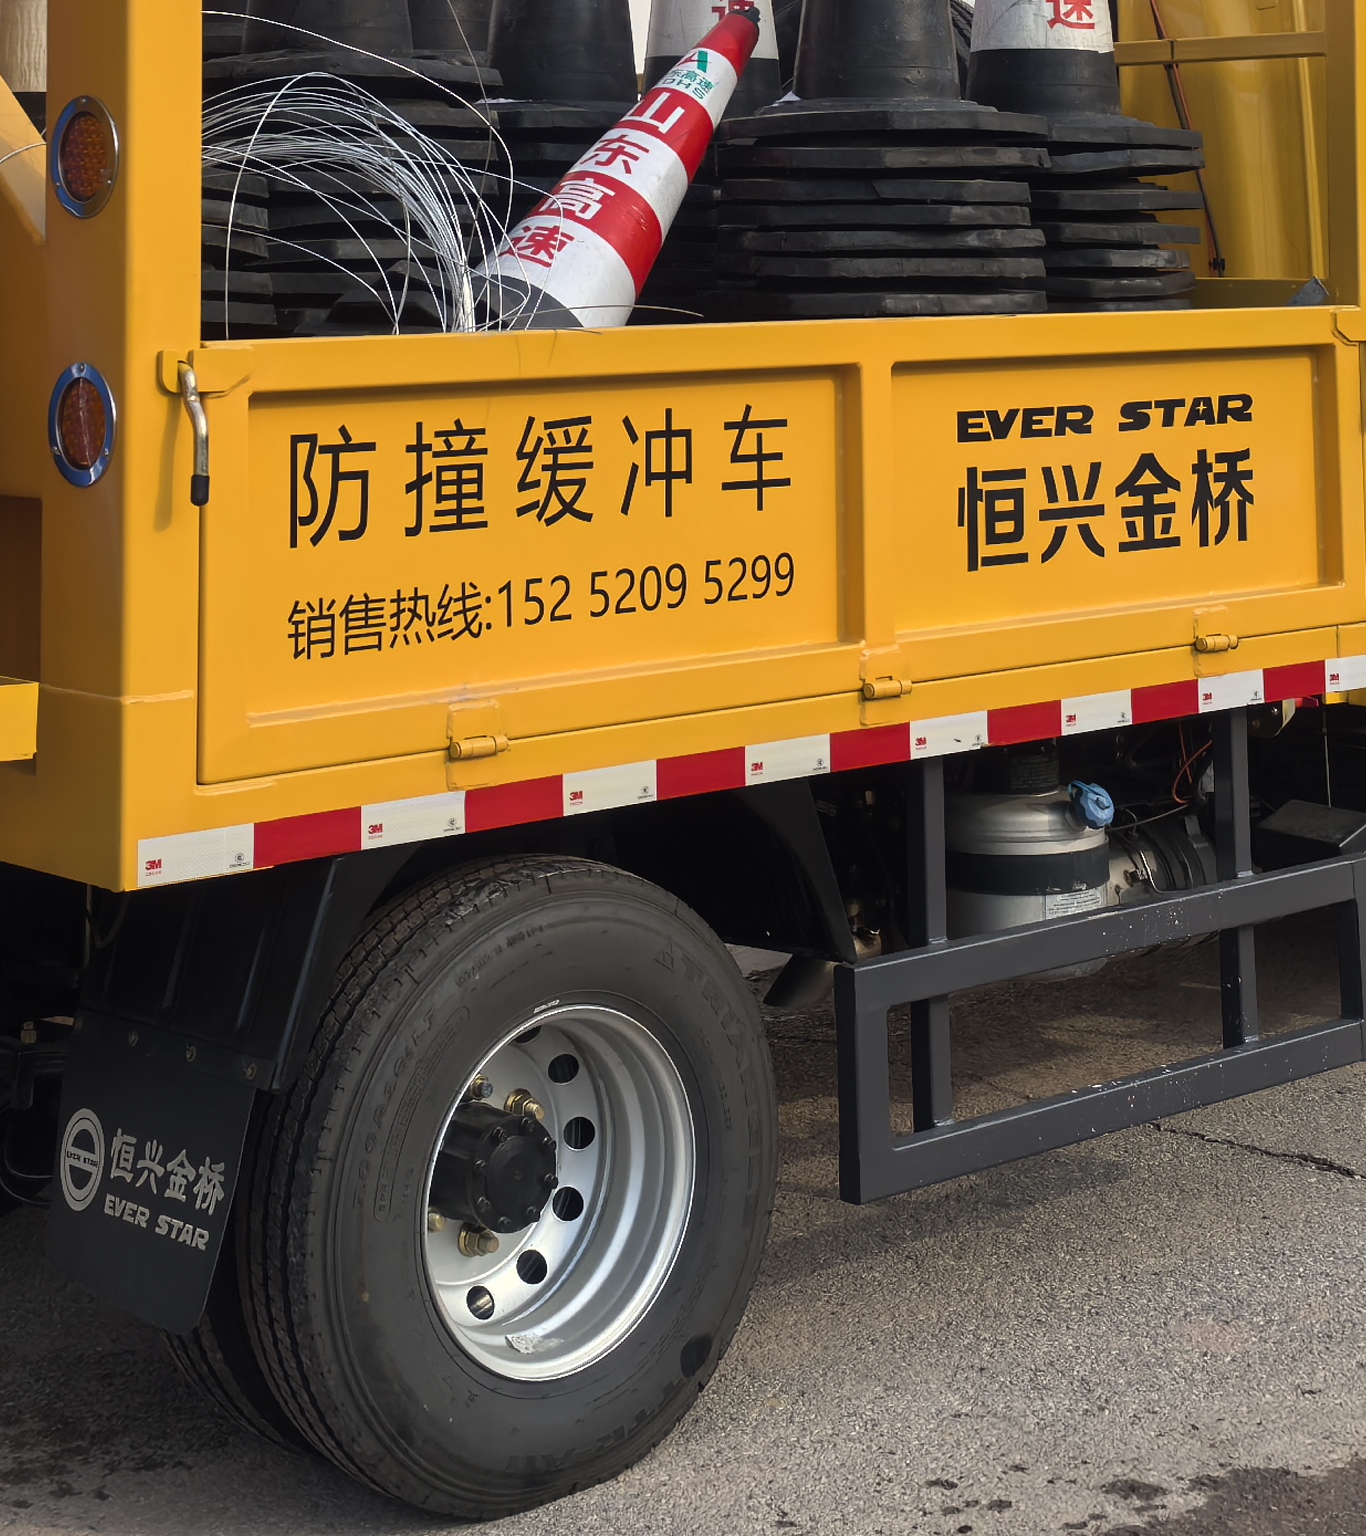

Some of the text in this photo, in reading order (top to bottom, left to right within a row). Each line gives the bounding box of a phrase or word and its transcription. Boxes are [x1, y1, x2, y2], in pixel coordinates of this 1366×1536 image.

[956, 393, 1254, 443] EVER STAR
[289, 404, 792, 549] 防撞缓冲车
[957, 447, 1255, 573] 恒兴金桥
[589, 562, 687, 618] 5209
[704, 552, 795, 606] 5299
[751, 761, 763, 772] 3M
[569, 790, 583, 801] 3M
[368, 823, 383, 834] 3M
[145, 859, 162, 871] 3M
[110, 1127, 225, 1216] 恒兴金桥
[104, 1193, 210, 1252] EVER STAR
